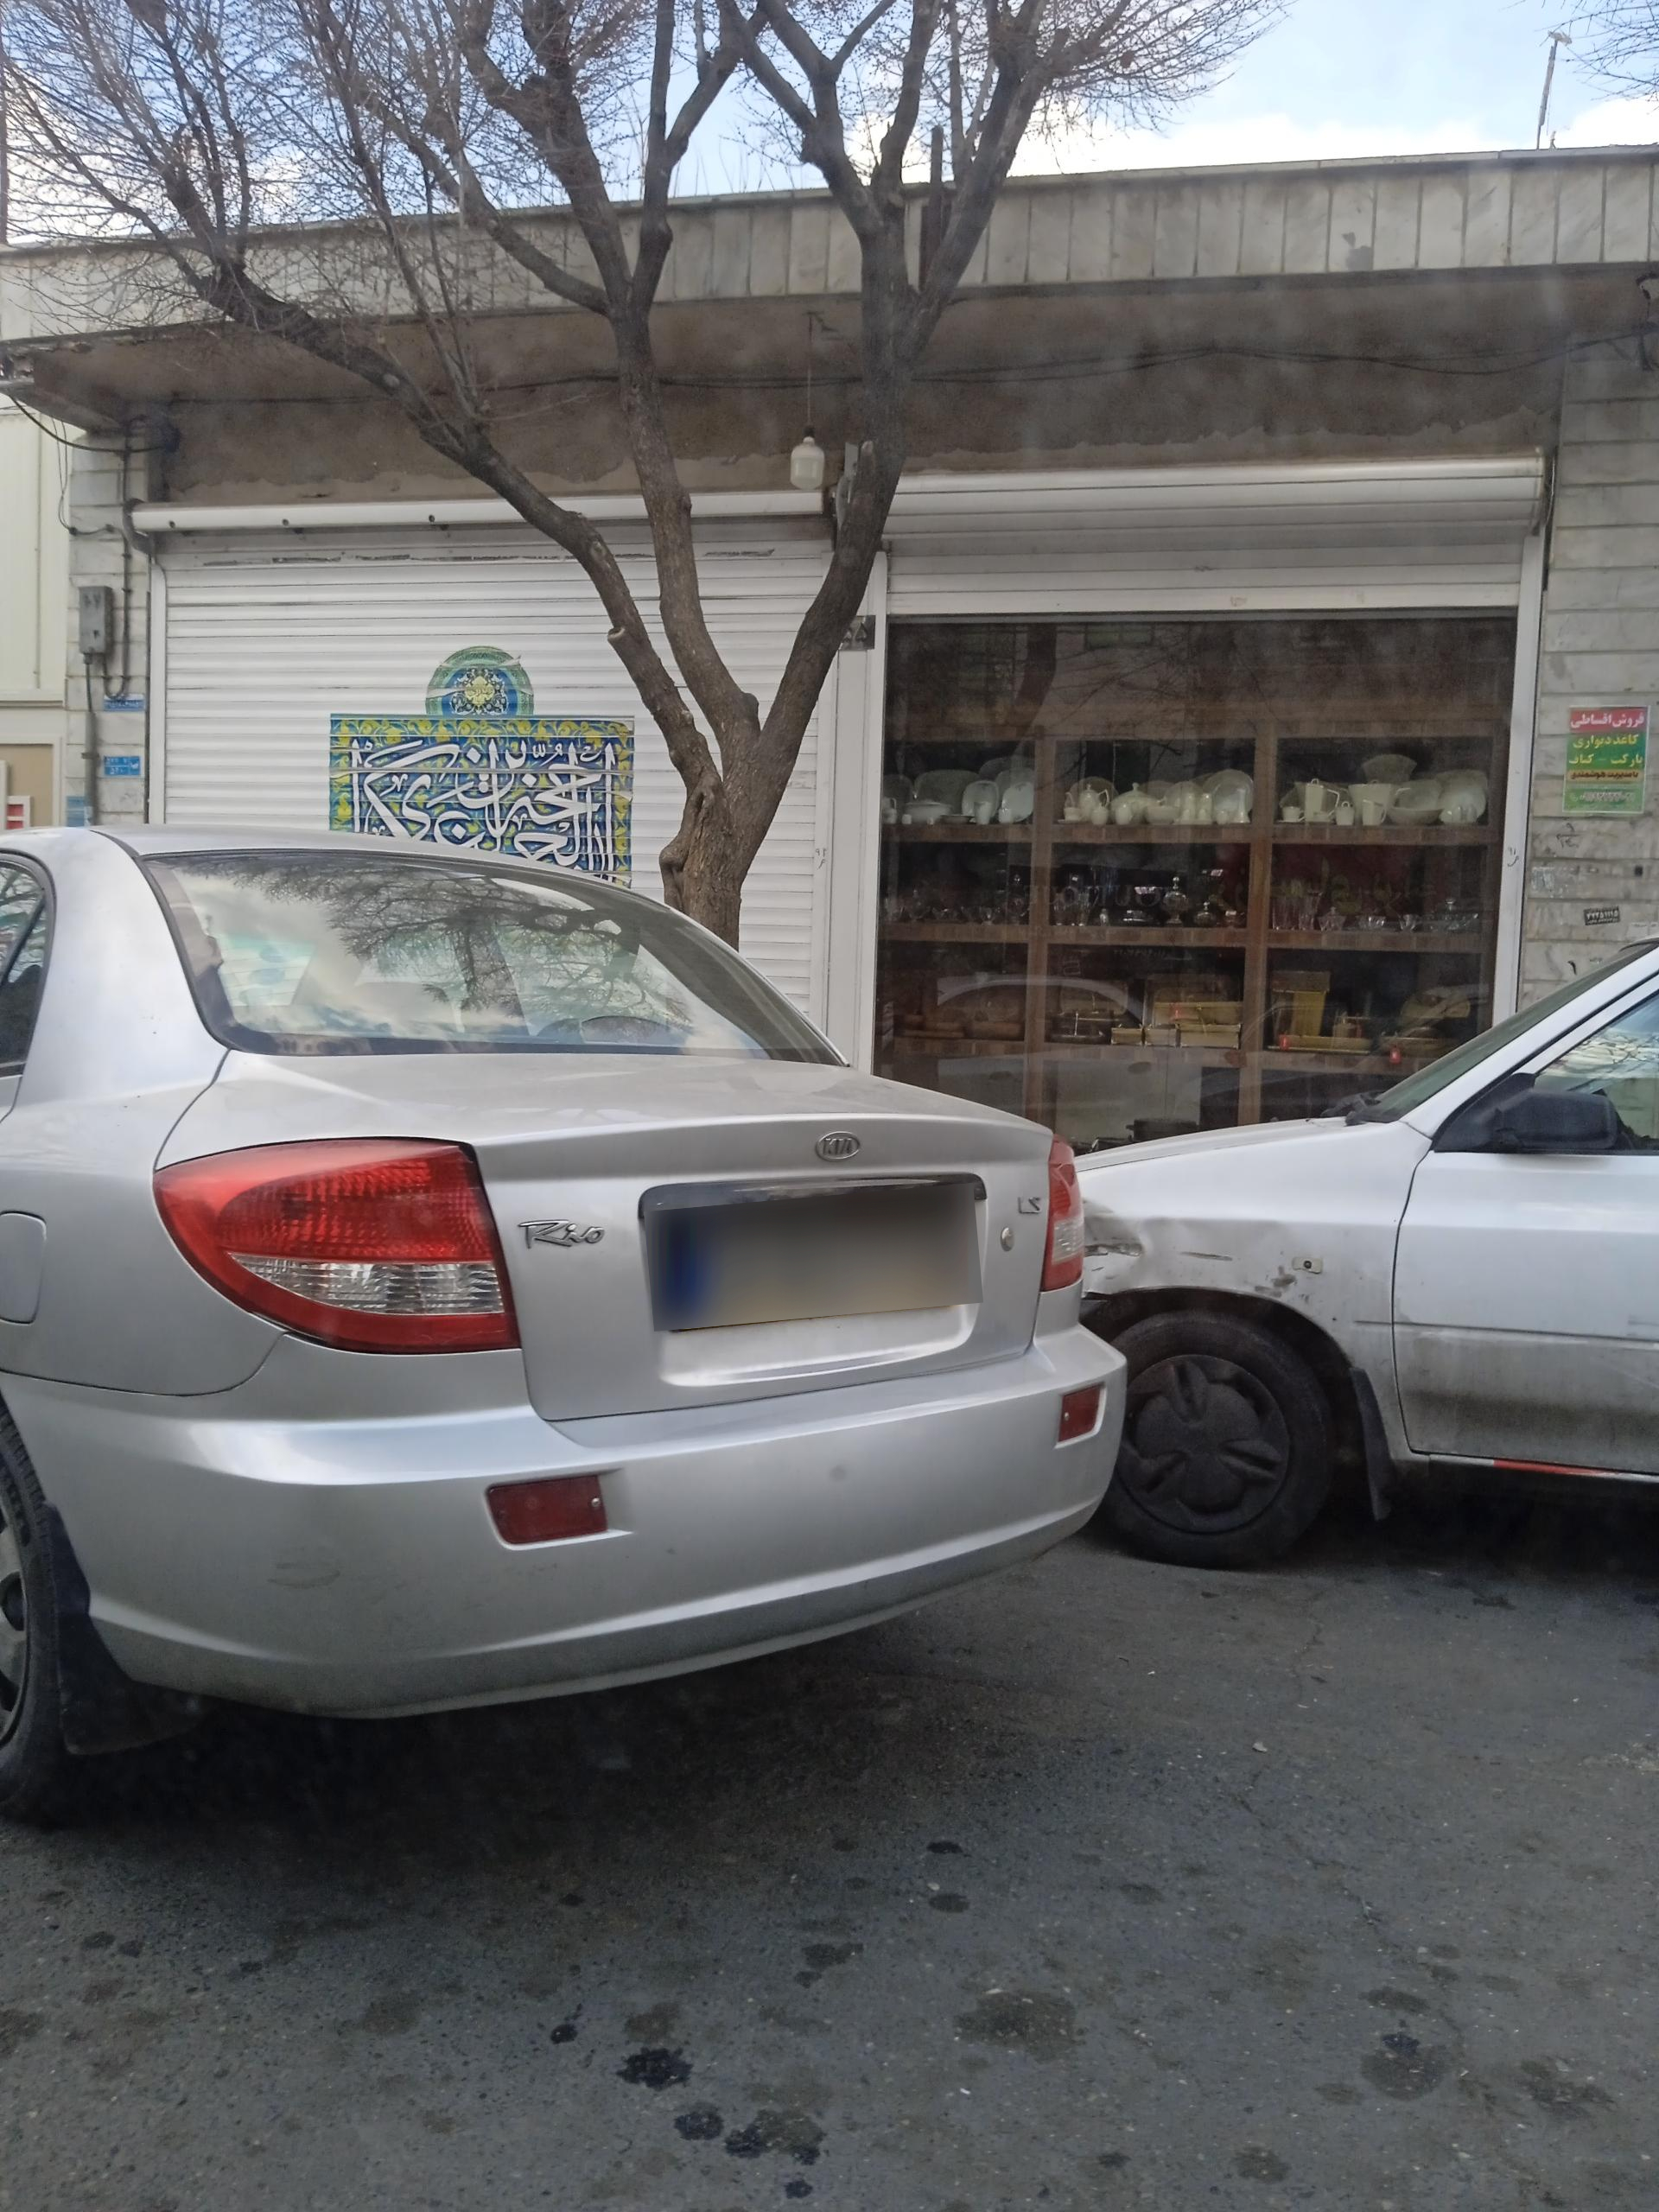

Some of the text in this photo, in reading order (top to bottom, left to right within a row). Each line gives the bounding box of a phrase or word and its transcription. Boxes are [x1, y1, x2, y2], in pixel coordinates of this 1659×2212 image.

[1570, 712, 1645, 729] فروش اقساطی
[517, 1218, 605, 1249] Rio
